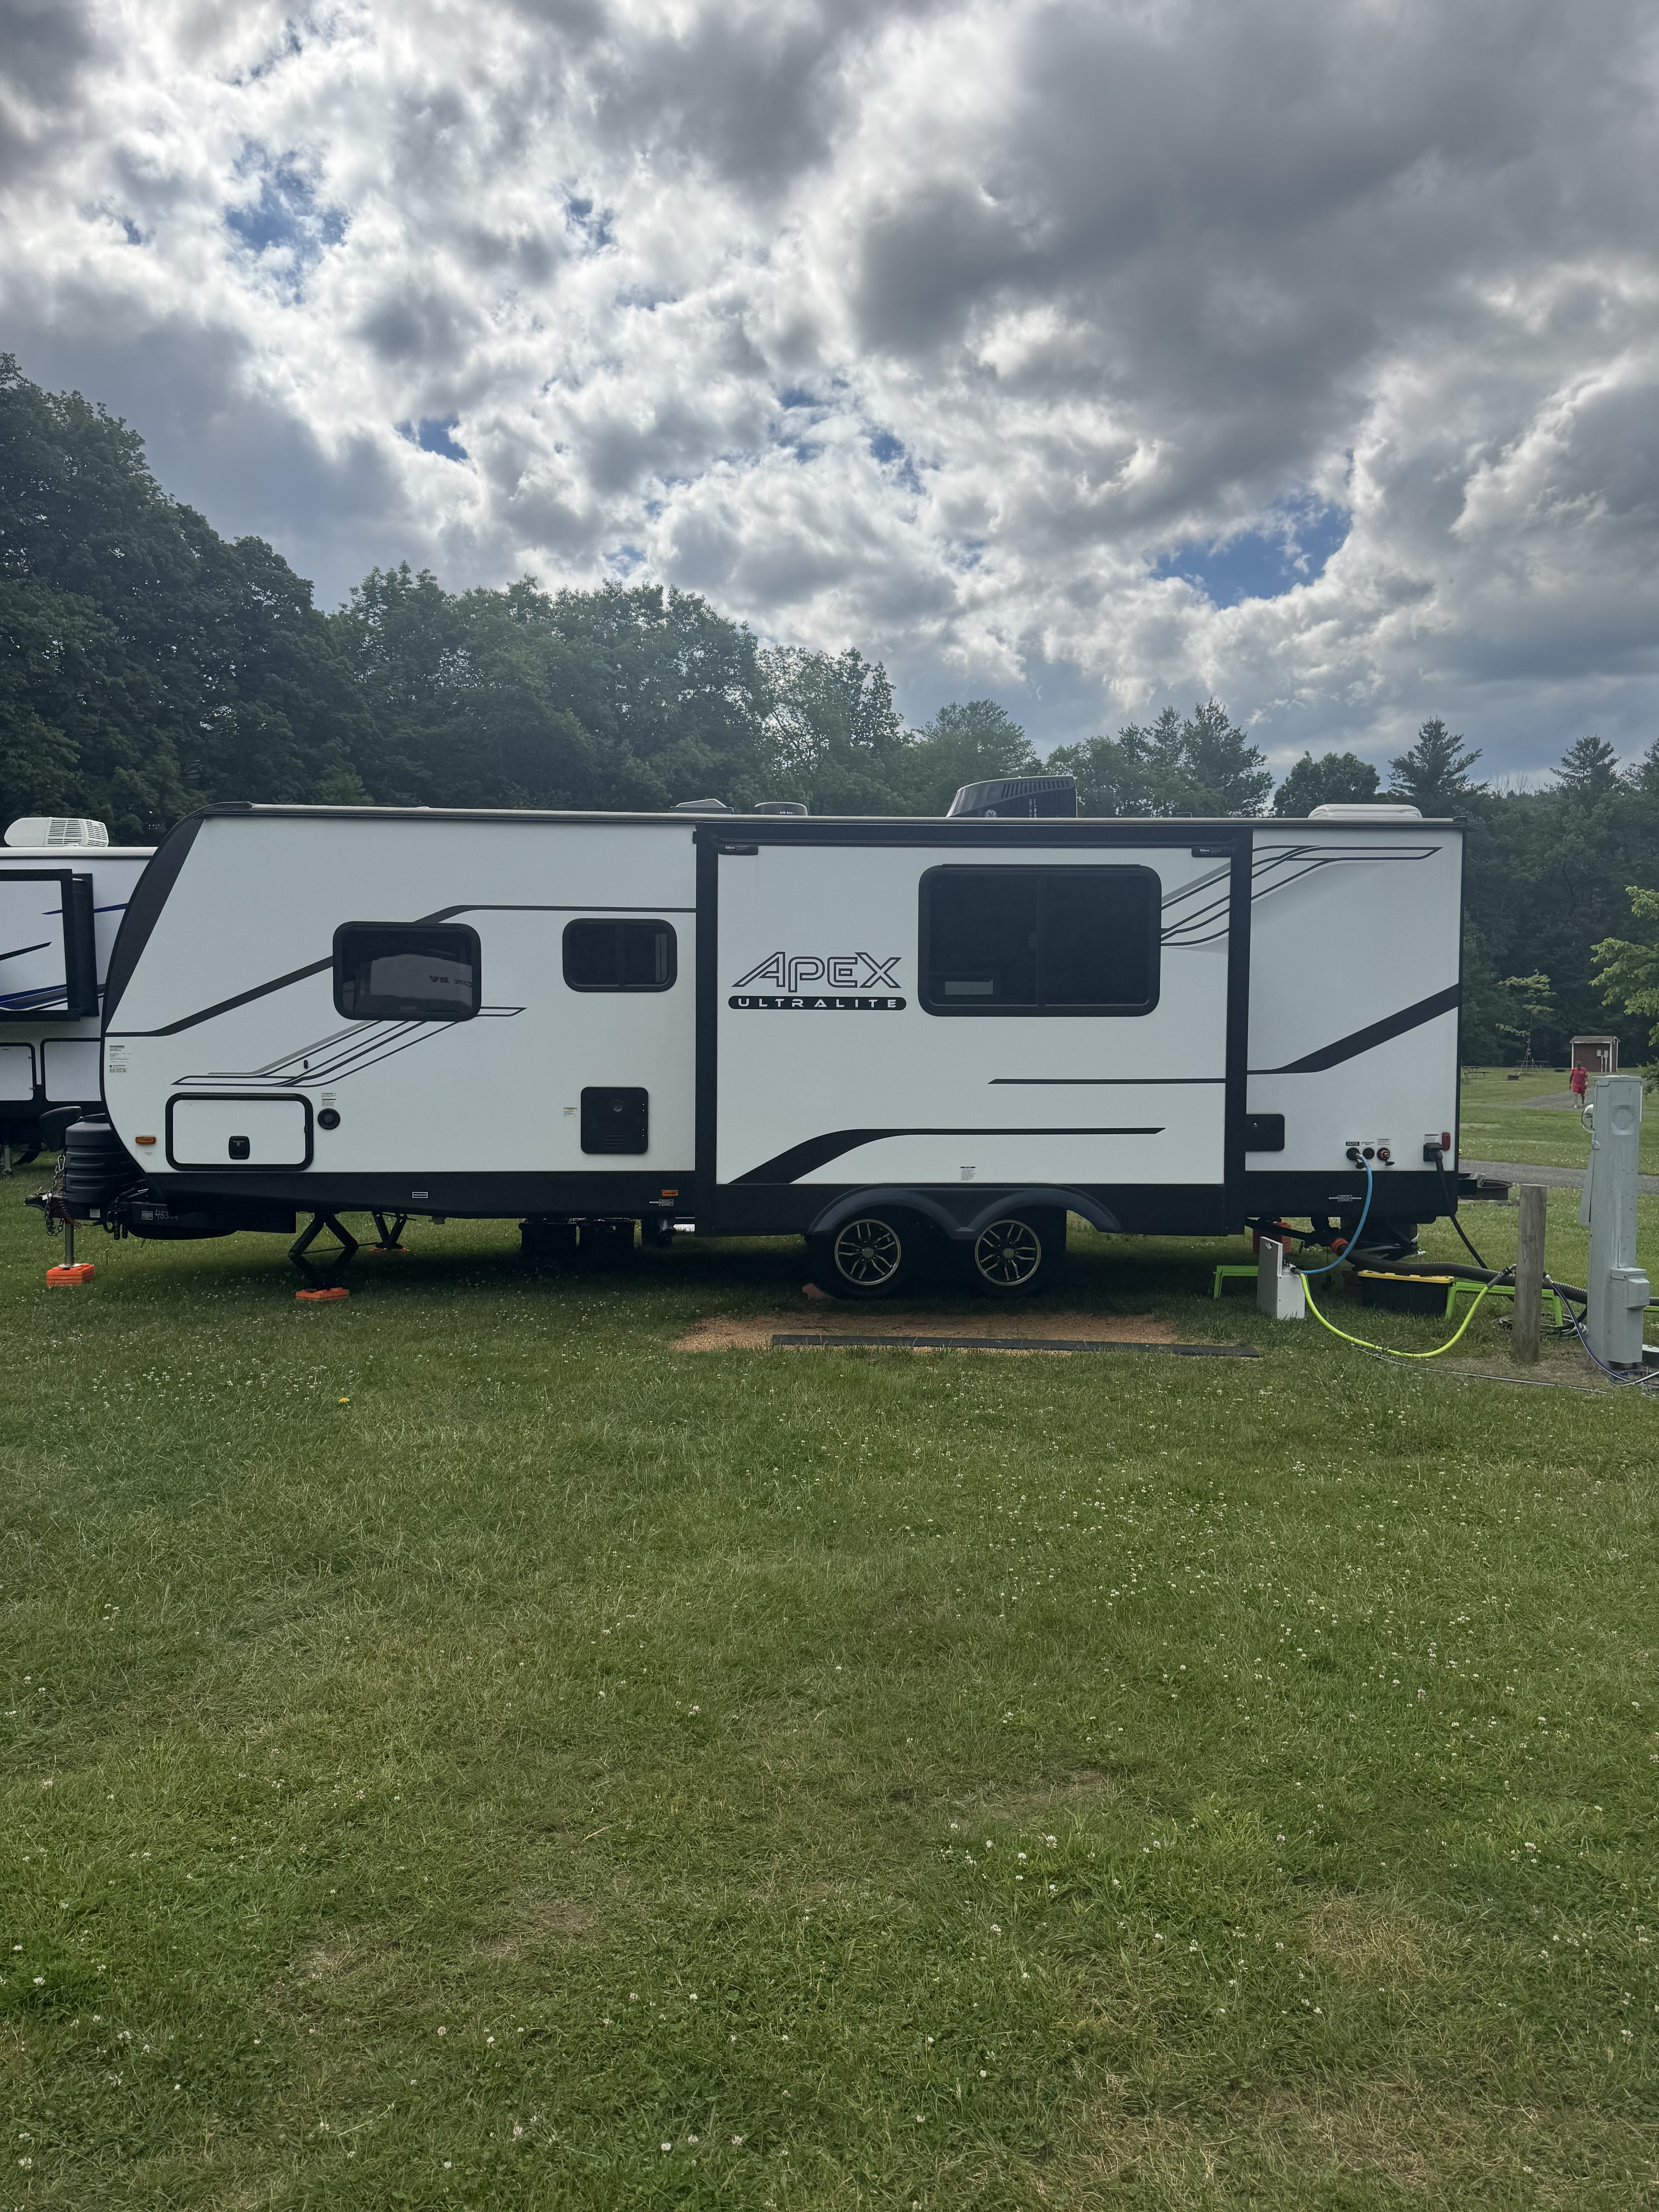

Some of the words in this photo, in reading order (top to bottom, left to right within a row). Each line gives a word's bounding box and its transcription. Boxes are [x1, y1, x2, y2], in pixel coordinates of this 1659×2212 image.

[731, 951, 902, 993] APEX
[738, 998, 896, 1008] ULTRALITE
[155, 1209, 169, 1220] 483
